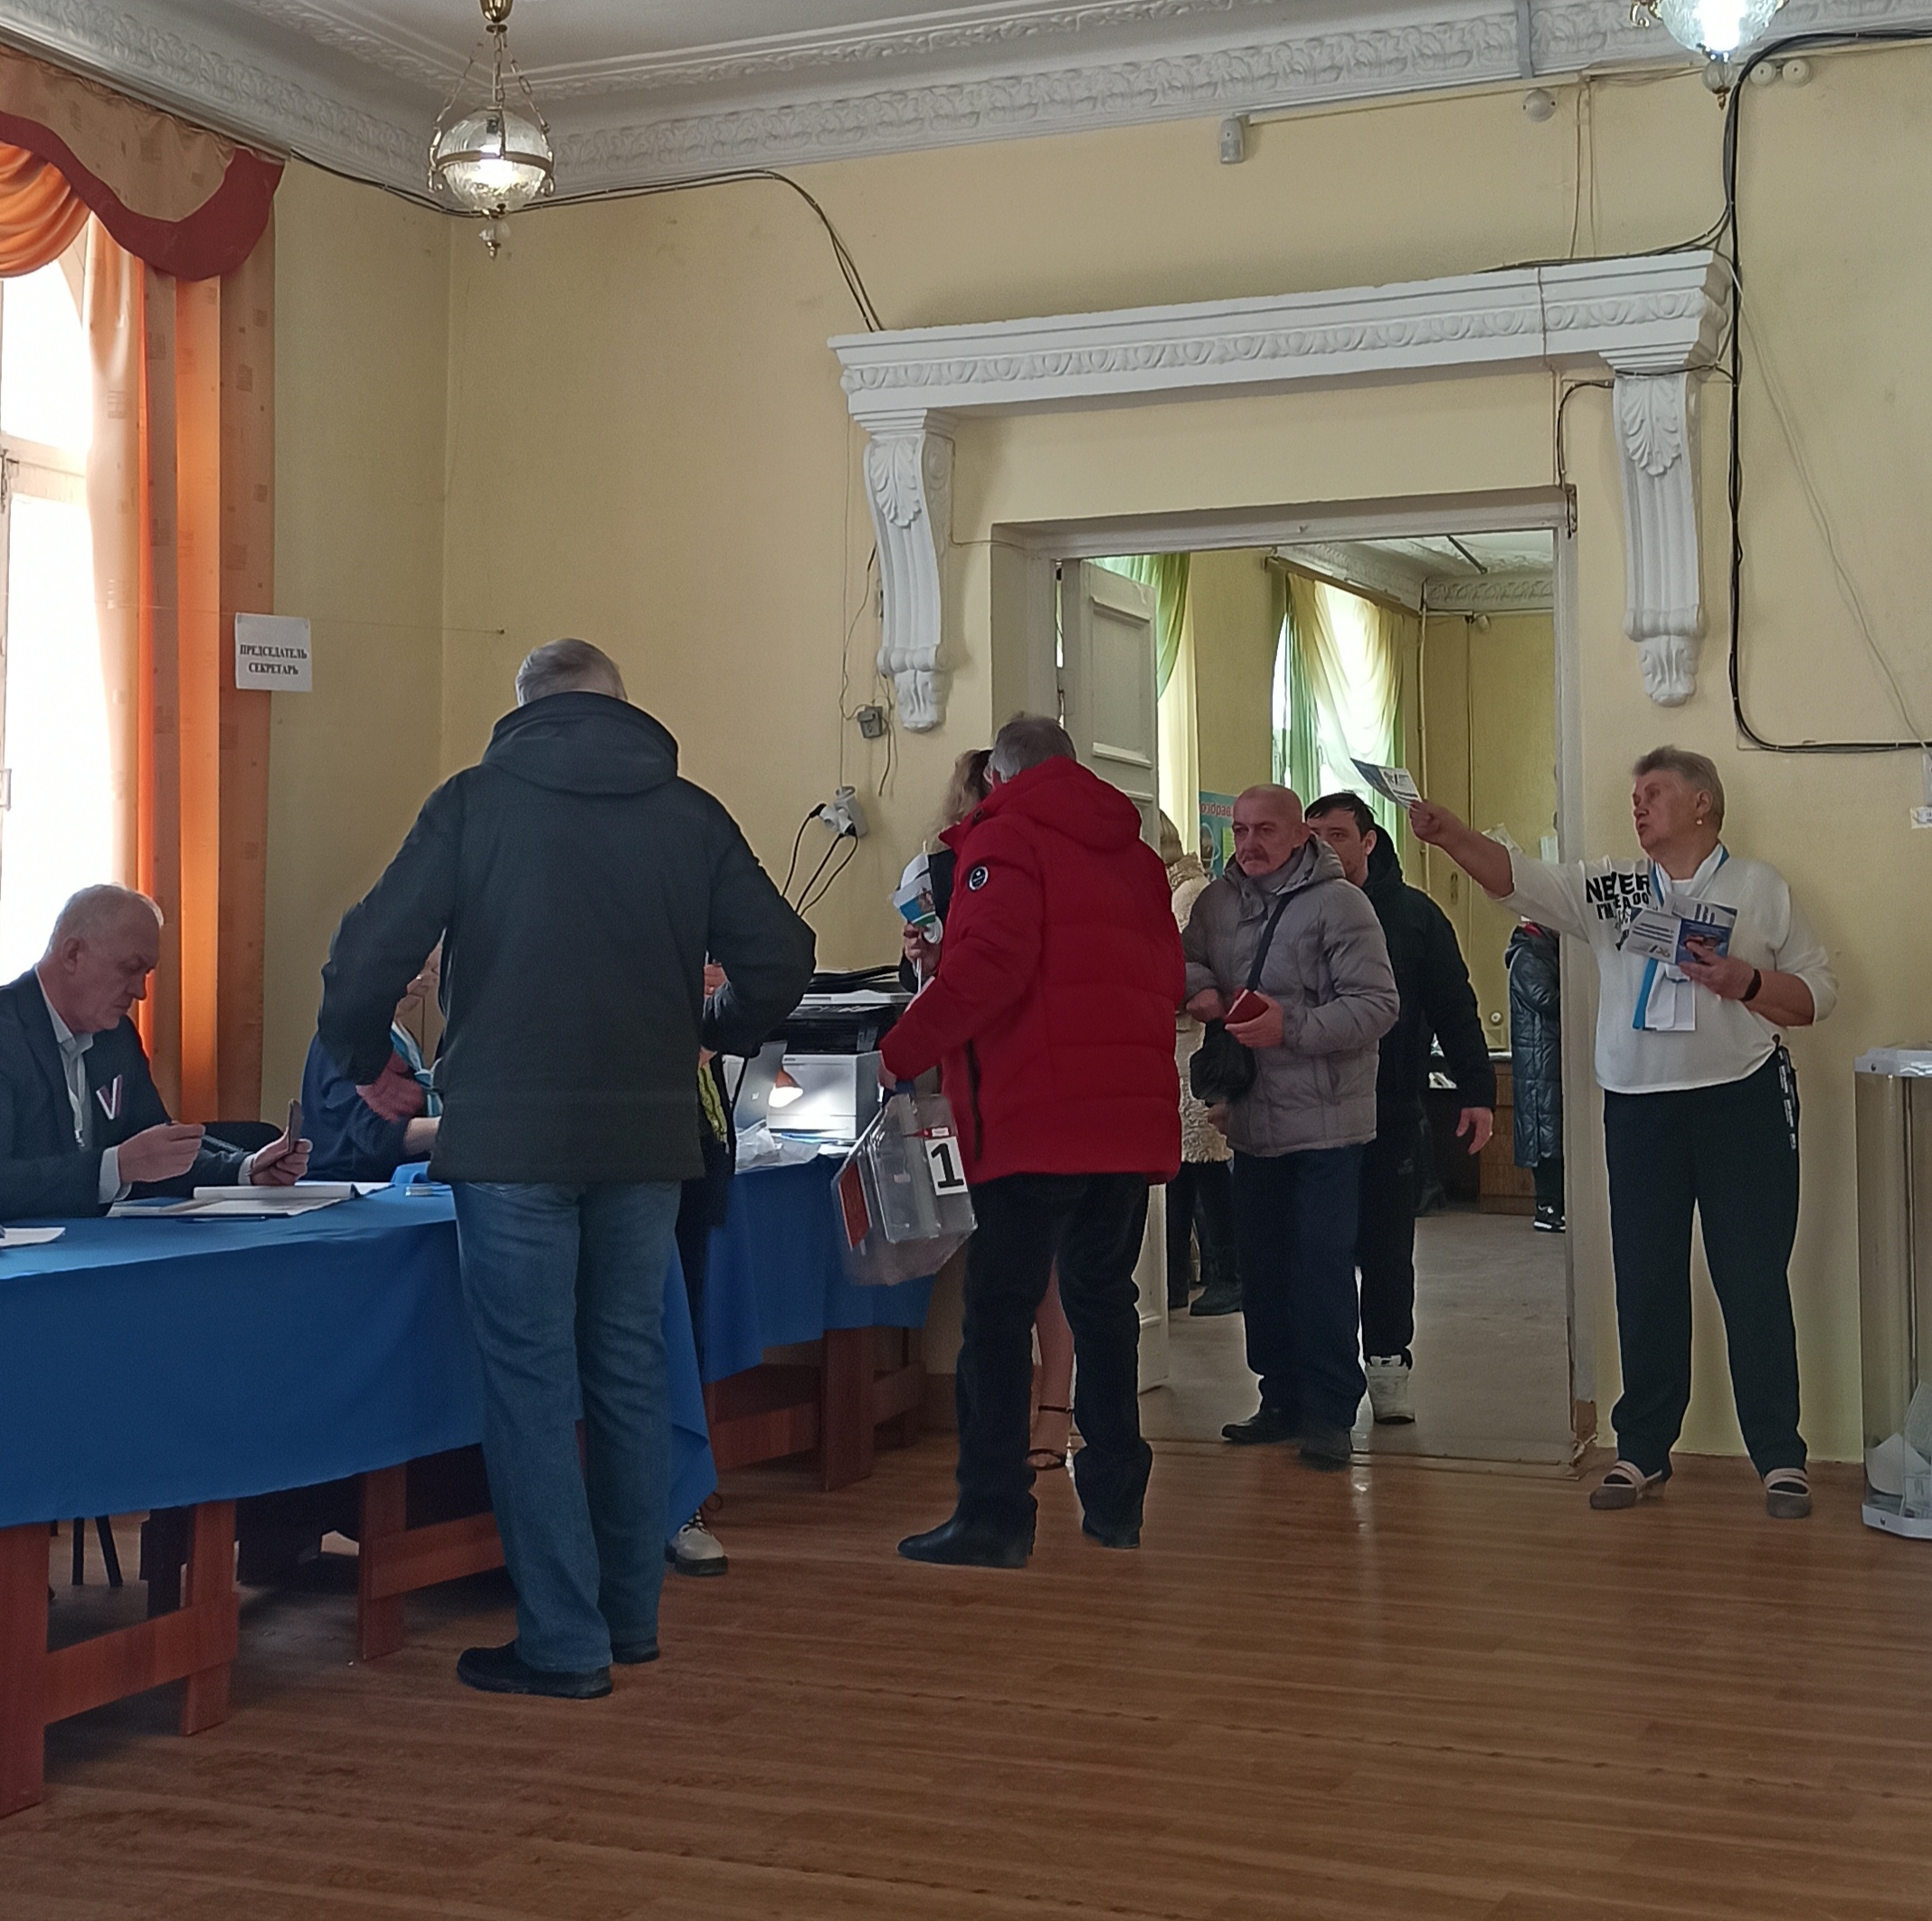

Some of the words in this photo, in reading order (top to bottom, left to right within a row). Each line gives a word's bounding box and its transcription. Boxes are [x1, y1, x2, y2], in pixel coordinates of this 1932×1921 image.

[240, 644, 308, 659] ПРЕДСЕДАТЕЛЬ
[248, 661, 299, 676] СЕКРЕТАРЬ
[931, 1142, 964, 1188] 1
